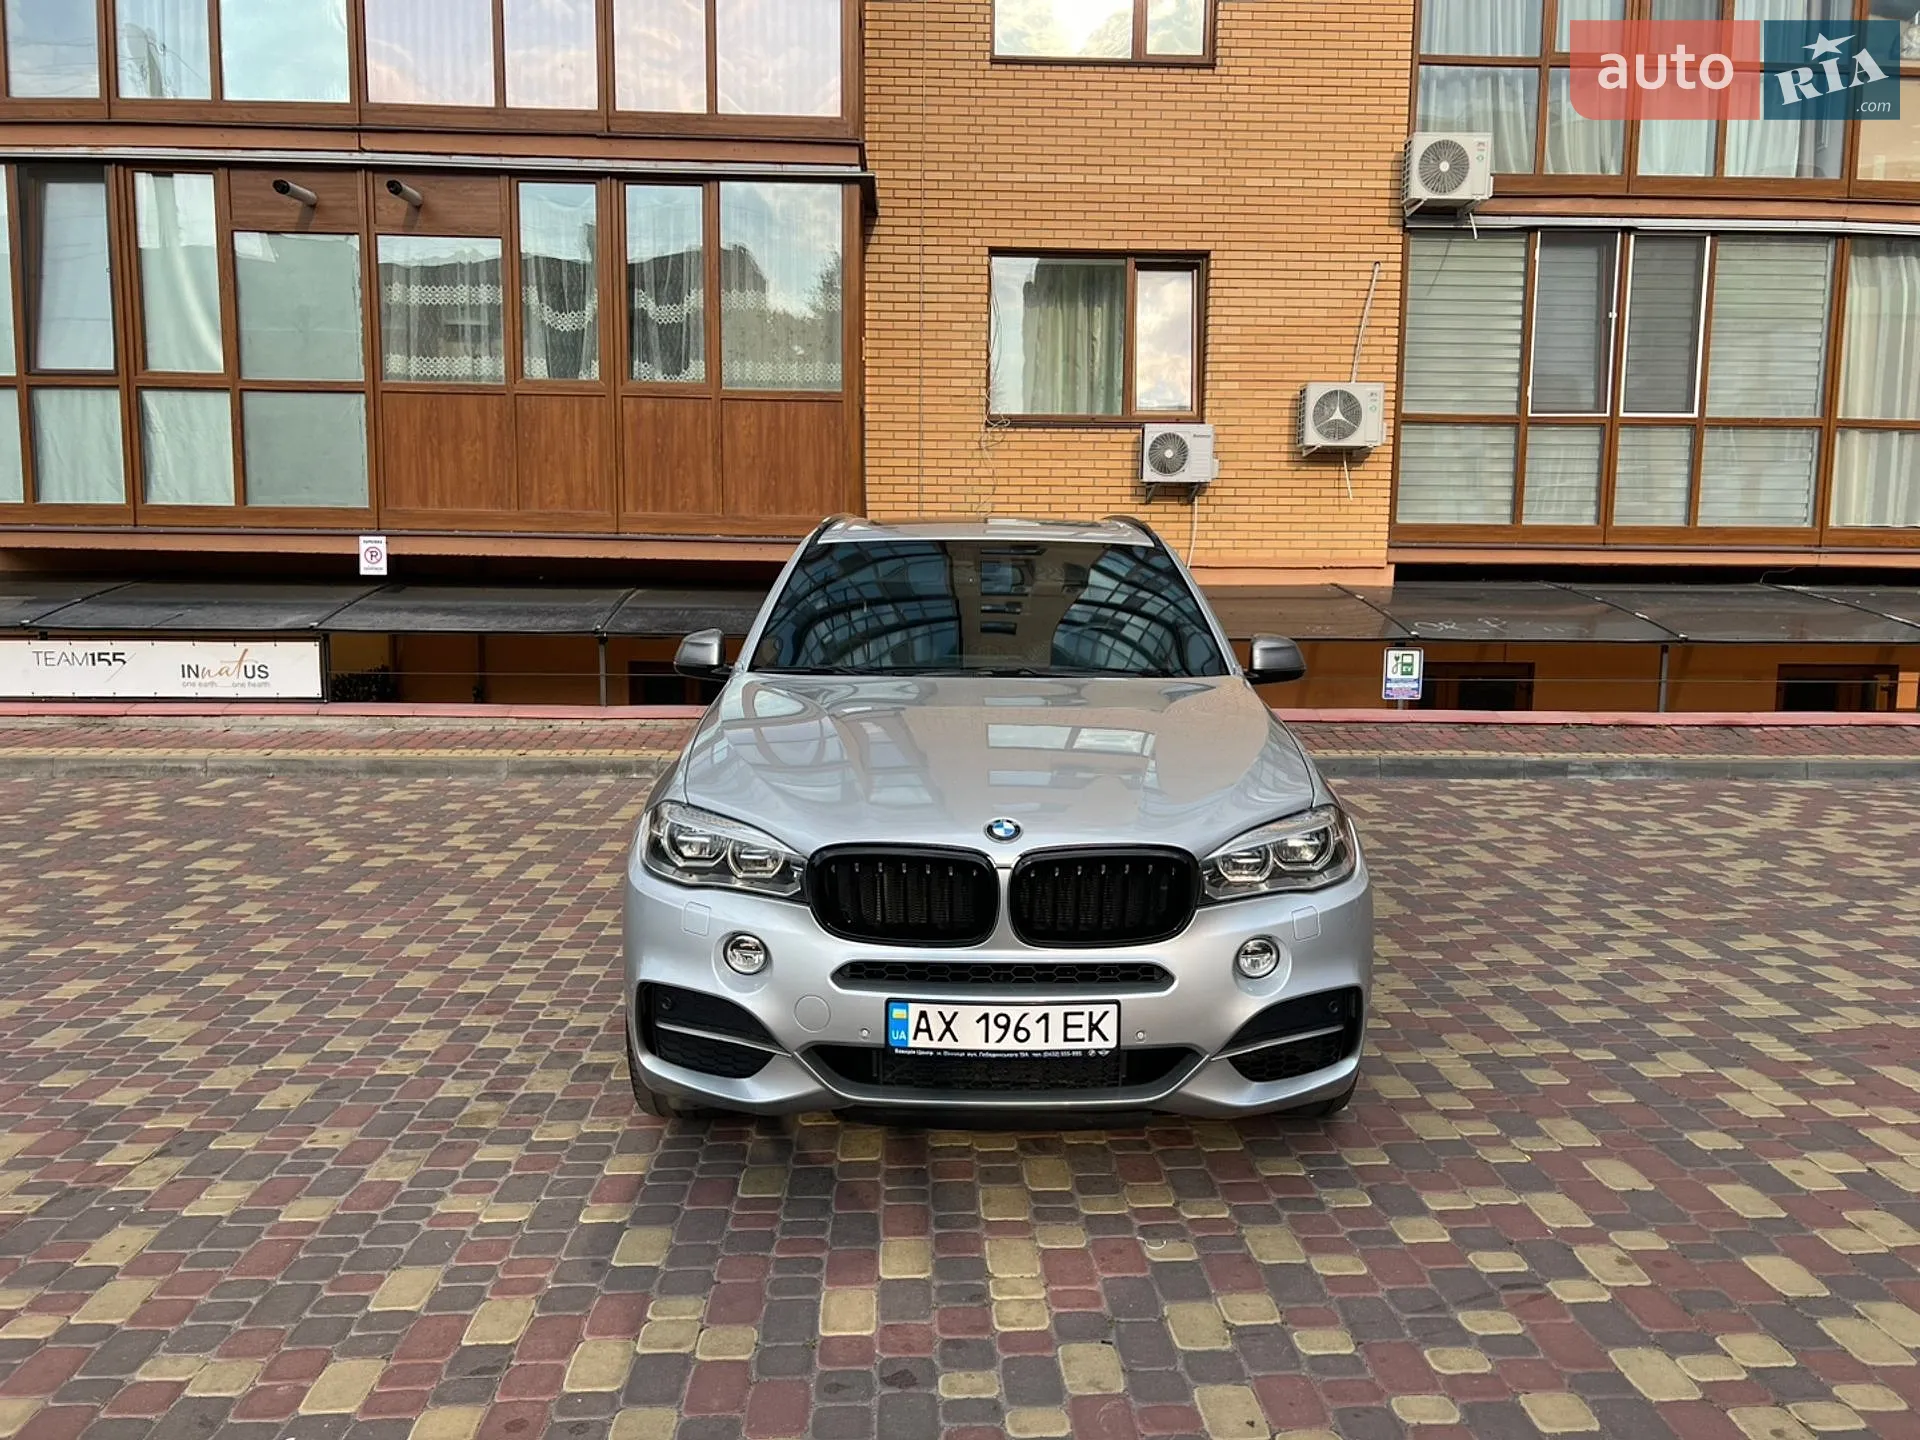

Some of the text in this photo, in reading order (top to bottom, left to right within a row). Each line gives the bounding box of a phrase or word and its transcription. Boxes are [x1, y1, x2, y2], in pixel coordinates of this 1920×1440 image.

[32, 650, 129, 668] TEAM155
[892, 1031, 907, 1041] UA
[912, 1010, 1110, 1044] AX 1961 EK
